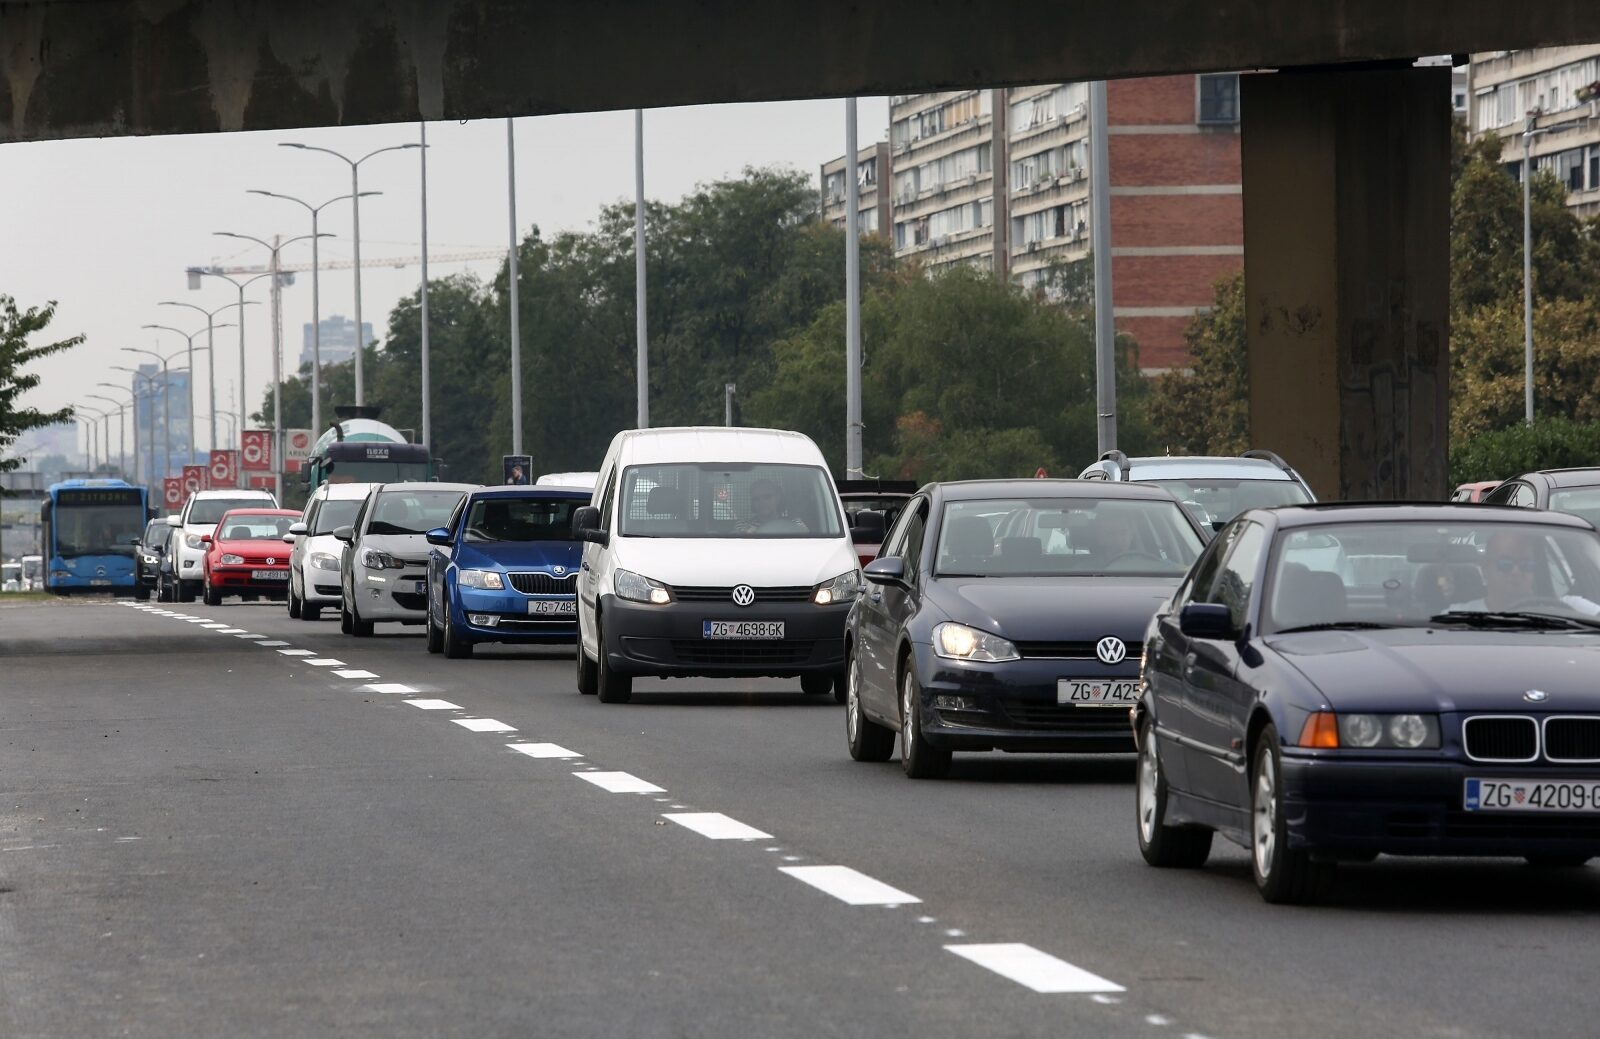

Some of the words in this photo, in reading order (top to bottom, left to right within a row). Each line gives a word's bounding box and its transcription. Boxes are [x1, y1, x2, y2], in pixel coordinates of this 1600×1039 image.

[536, 602, 548, 613] ZG
[713, 623, 728, 636] ZG
[1071, 683, 1090, 700] ZG
[1483, 783, 1511, 808] ZG
